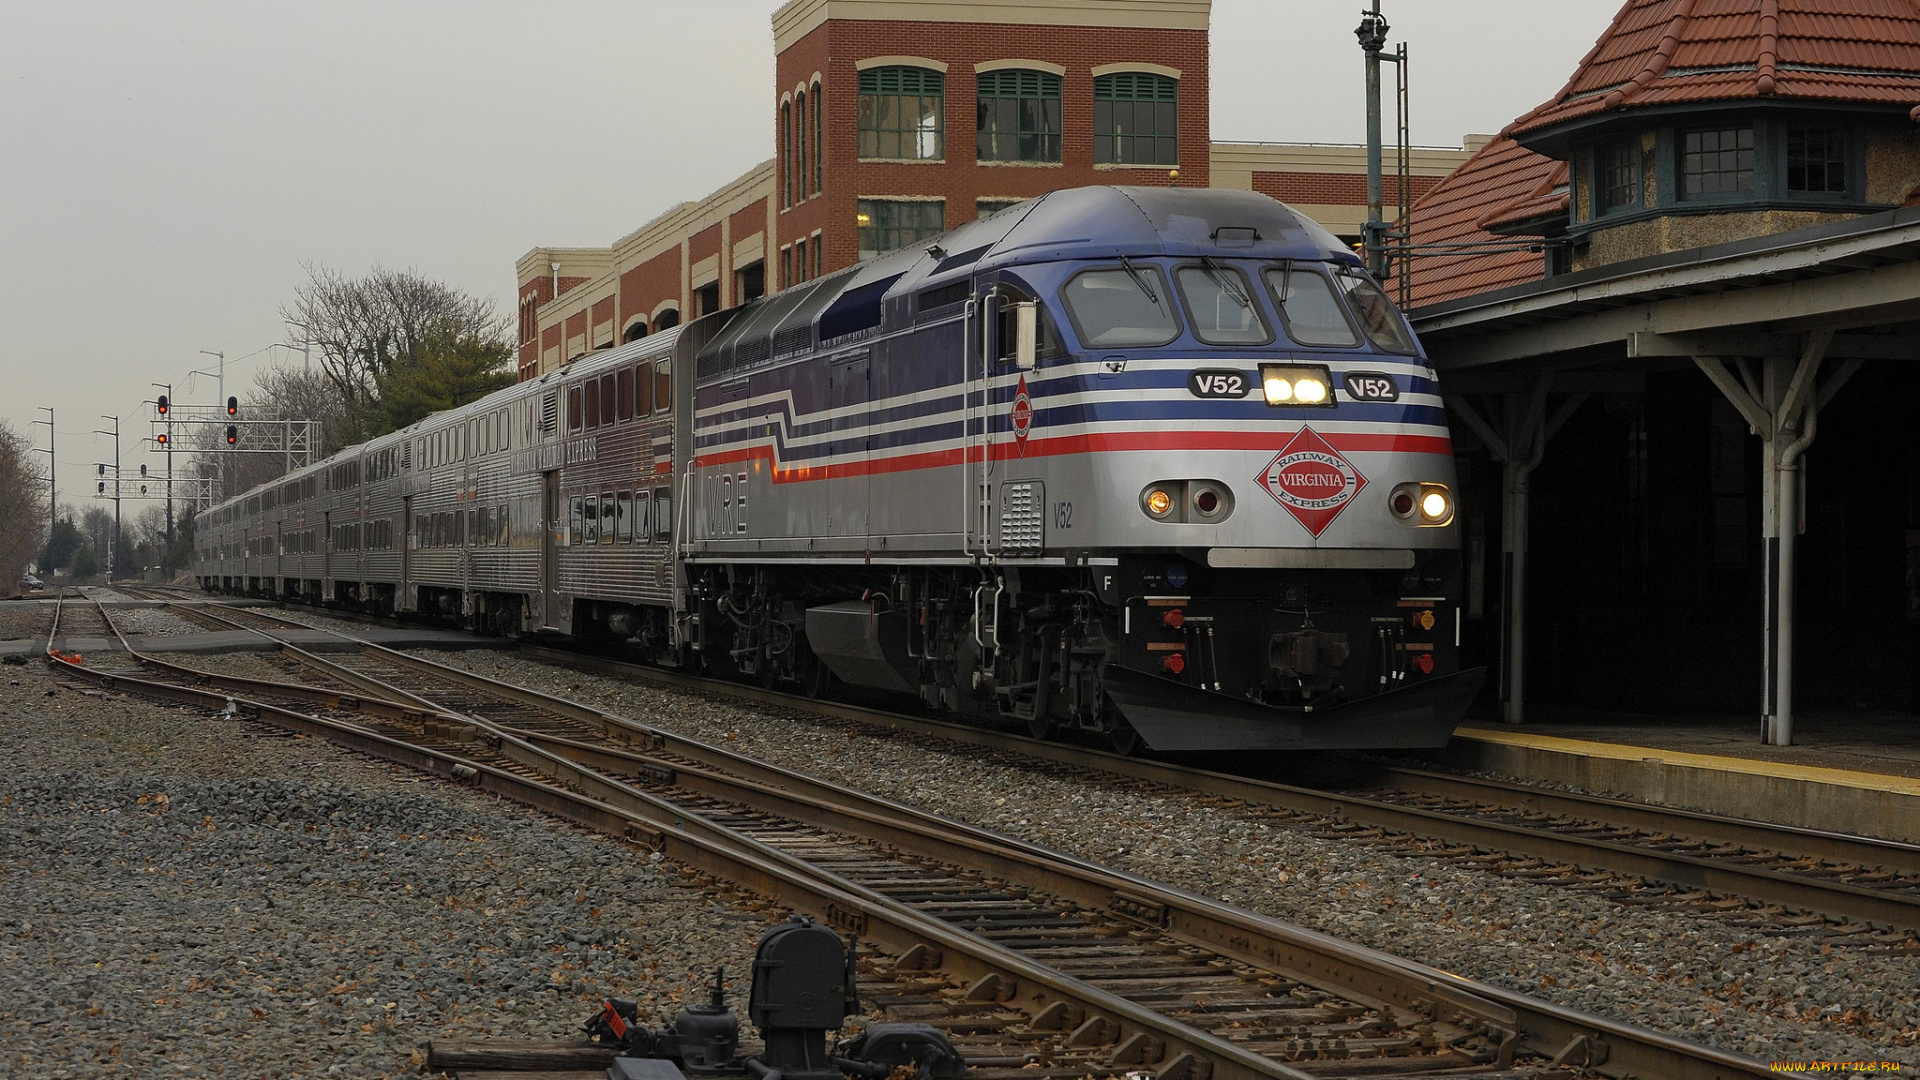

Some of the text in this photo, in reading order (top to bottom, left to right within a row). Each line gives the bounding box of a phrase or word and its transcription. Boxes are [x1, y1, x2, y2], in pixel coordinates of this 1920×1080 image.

[1195, 375, 1243, 394] V52
[1348, 378, 1394, 398] V52
[566, 437, 597, 464] EXPRESS
[1277, 453, 1346, 469] RAILWAY
[1280, 473, 1343, 487] VIRGINIA
[708, 471, 747, 535] VRE
[1278, 490, 1348, 508] EXPRESS
[1054, 501, 1072, 529] V52
[1104, 576, 1111, 590] F
